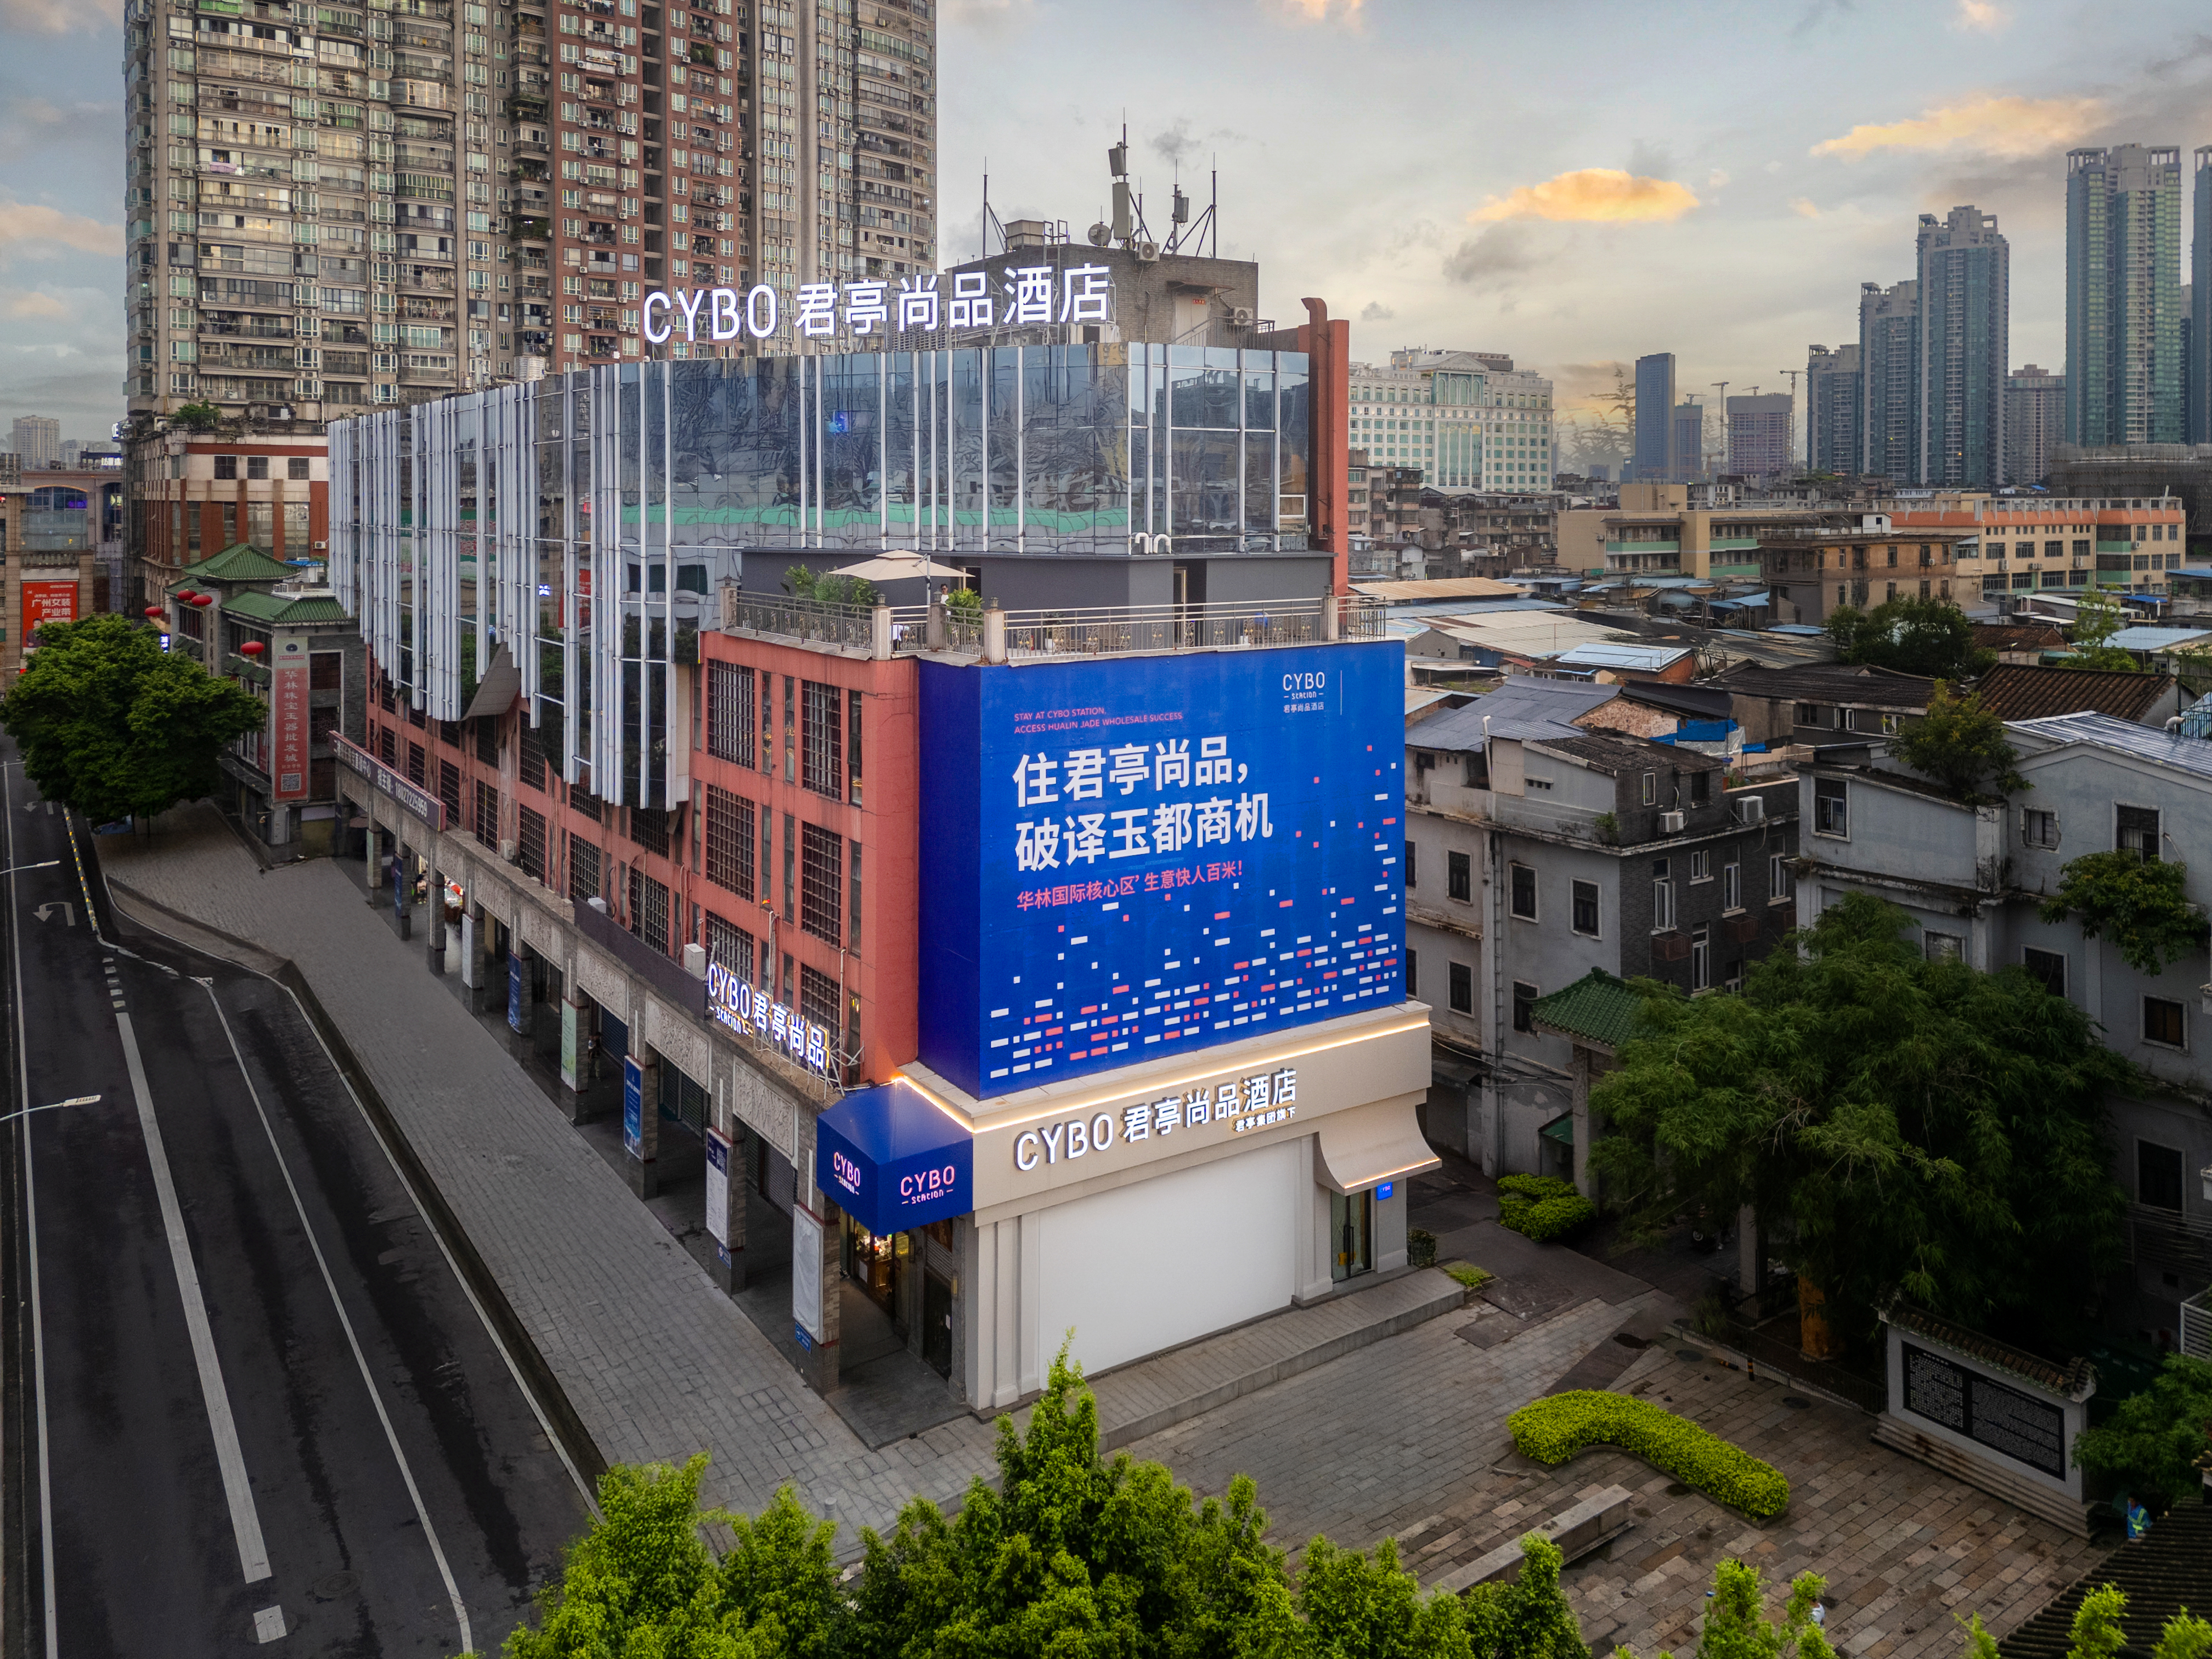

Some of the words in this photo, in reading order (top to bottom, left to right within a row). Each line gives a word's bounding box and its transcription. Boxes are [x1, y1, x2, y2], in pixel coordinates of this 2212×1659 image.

[643, 284, 778, 344] CYBO
[794, 263, 1110, 336] 君亭尚品酒店
[31, 598, 71, 607] 广州女装
[42, 608, 71, 617] 产业带
[1283, 672, 1325, 691] CYBO
[284, 671, 298, 762] 华林珠宝玉器批发城
[1014, 713, 1032, 721] STAY
[1047, 709, 1070, 719] CYBO
[1284, 702, 1324, 713] 君亭尚品酒店
[1014, 724, 1046, 734] ACCESS
[1048, 720, 1078, 730] HUALIN
[1080, 719, 1100, 729] JADE
[1102, 715, 1147, 726] WHOLESALE
[1015, 793, 1273, 872] 破译玉都商机
[708, 963, 752, 1019] CYBO
[754, 991, 826, 1070] 君亭尚品
[1015, 1113, 1114, 1171] CYBO
[1121, 1068, 1296, 1143] 君亭尚品酒店
[1235, 1106, 1296, 1132] 君亭集团旗下
[834, 1152, 861, 1187] CYBO
[900, 1166, 955, 1196] CYBO
